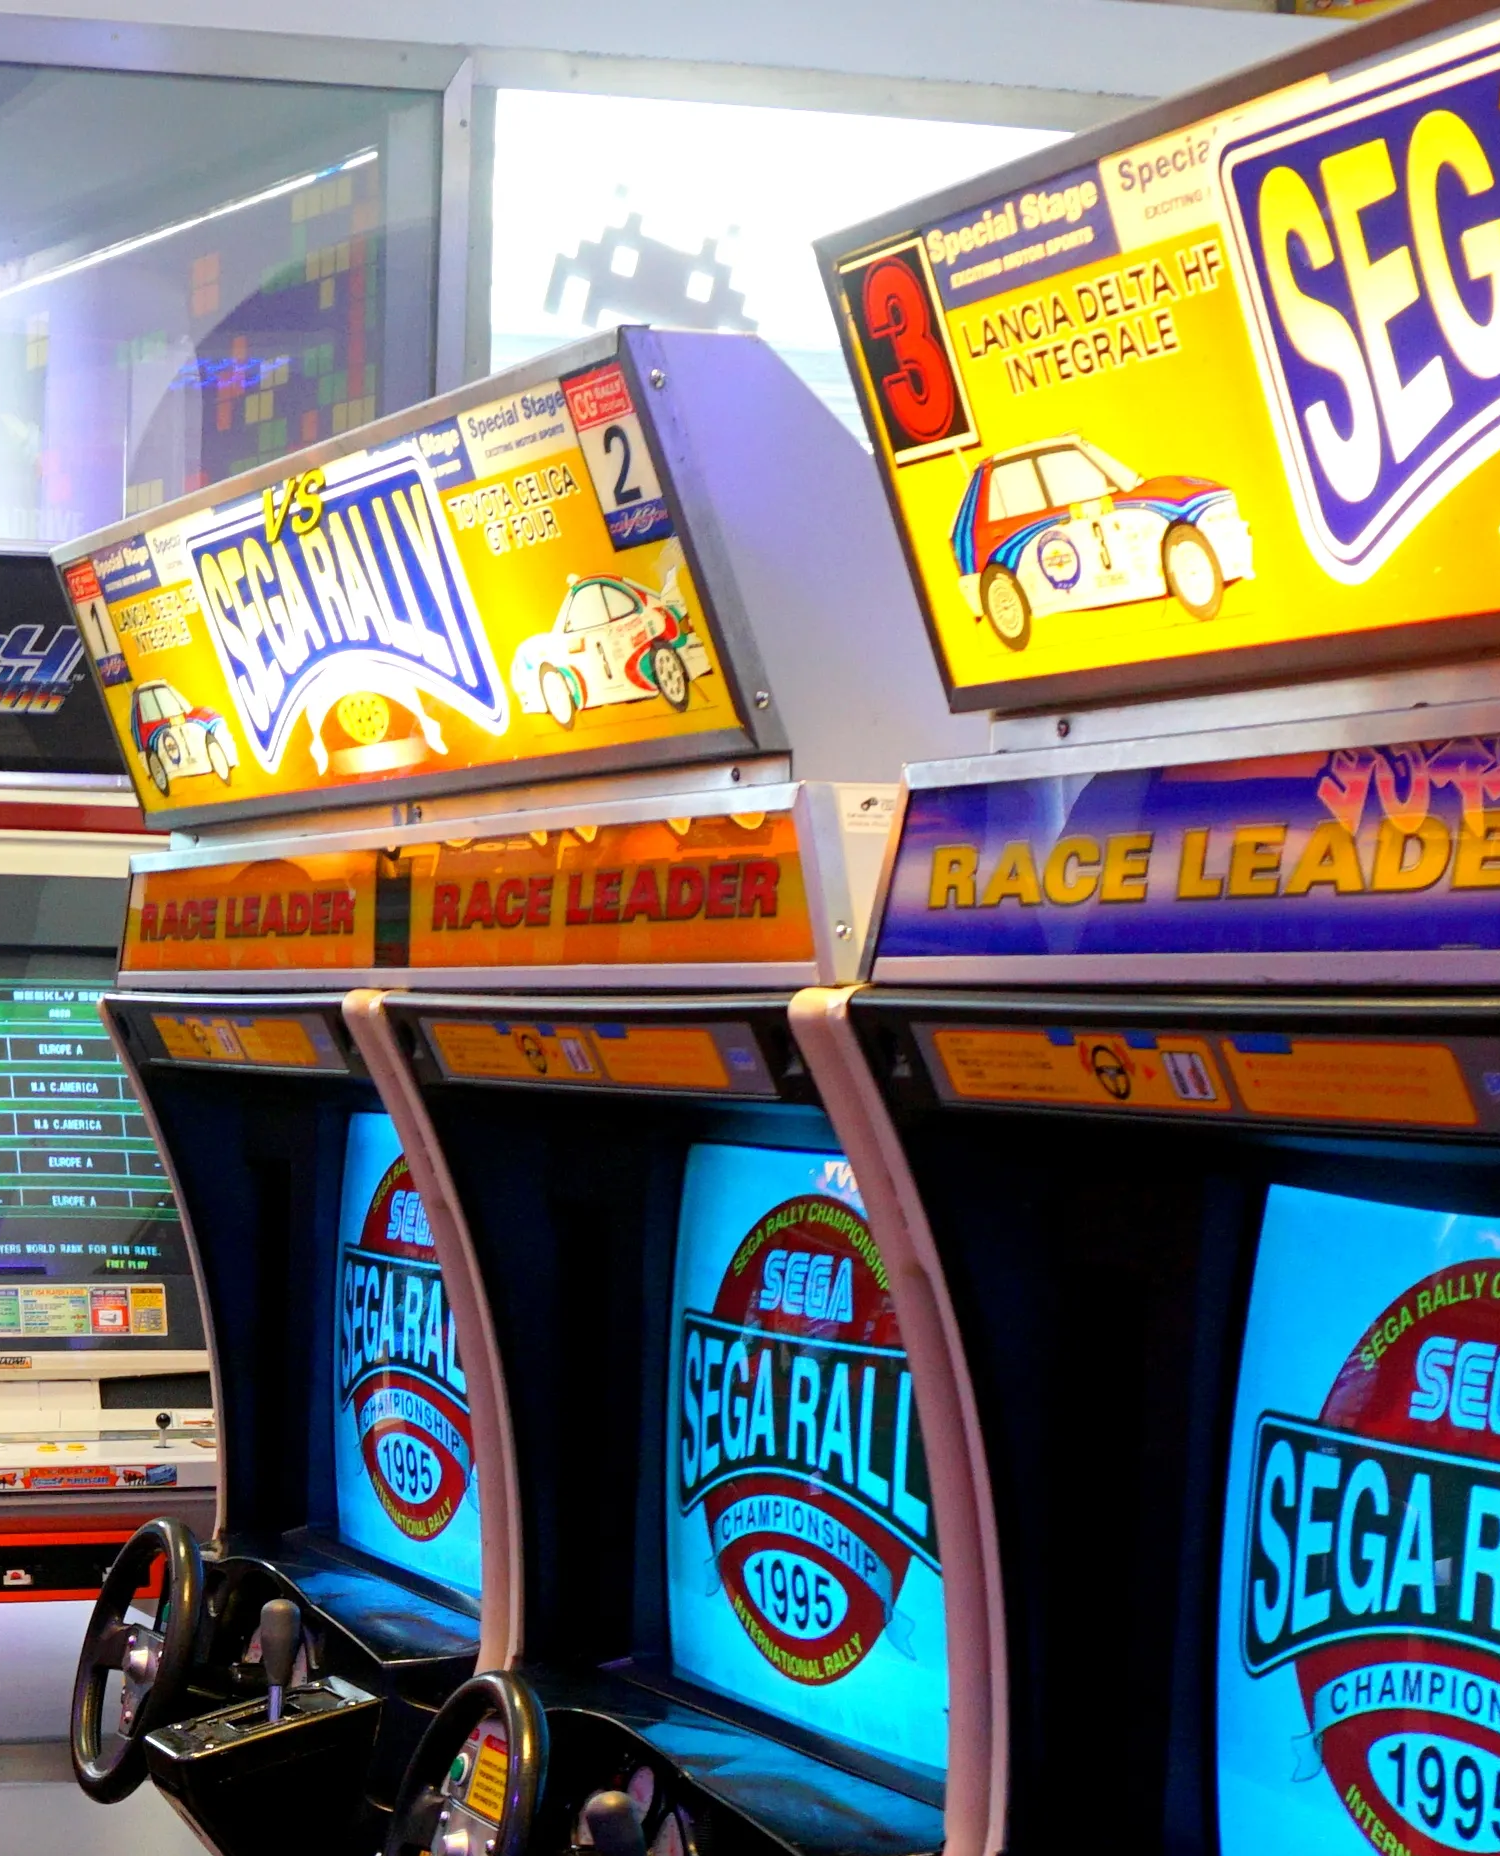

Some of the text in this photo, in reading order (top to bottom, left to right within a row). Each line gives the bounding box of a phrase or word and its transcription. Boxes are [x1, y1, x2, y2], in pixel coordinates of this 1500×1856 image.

[927, 181, 1099, 266] Special Stage
[963, 243, 1223, 359] LANCIA DELTA HF
[864, 256, 954, 441] 3
[1005, 313, 1178, 396] INTEGRALE
[468, 389, 565, 440] Special Stage
[573, 392, 598, 420] CG
[450, 464, 580, 530] TOYOTA CELICA
[604, 424, 642, 505] 2
[263, 468, 325, 543] VS
[512, 507, 561, 547] FOUR
[1090, 517, 1113, 570] 3
[90, 601, 110, 654] 1
[201, 484, 479, 731] SEGA RALLY
[430, 860, 783, 931] RACE LEADER
[928, 833, 1154, 911] RACE
[140, 887, 356, 941] RACE LEADER
[13, 990, 74, 1002] WEEKLY
[39, 1043, 71, 1055] EUROPE
[48, 1156, 81, 1168] EUROPE
[51, 1195, 85, 1207] EUROPE
[25, 1245, 57, 1257] WORLD
[60, 1245, 84, 1257] RANK
[89, 1245, 107, 1257] FOR
[111, 1245, 131, 1257] WIN
[105, 1259, 127, 1270] FREE
[128, 1259, 149, 1270] PLAY
[732, 1202, 808, 1277] SEGA RALLY
[758, 1249, 853, 1324] SEGA
[1360, 1304, 1414, 1370] SEGA
[1416, 1272, 1489, 1320] RALLY
[341, 1261, 395, 1390] SEGA
[362, 1390, 461, 1453] CHAMPIONSHIP
[681, 1330, 775, 1489] SEGA
[382, 1440, 433, 1498] 1995
[721, 1493, 878, 1579] CHAMPIONSHIP
[1252, 1439, 1439, 1645] SEGA
[753, 1554, 834, 1632] 1995
[733, 1593, 864, 1681] INTERNATIONAL RALLY
